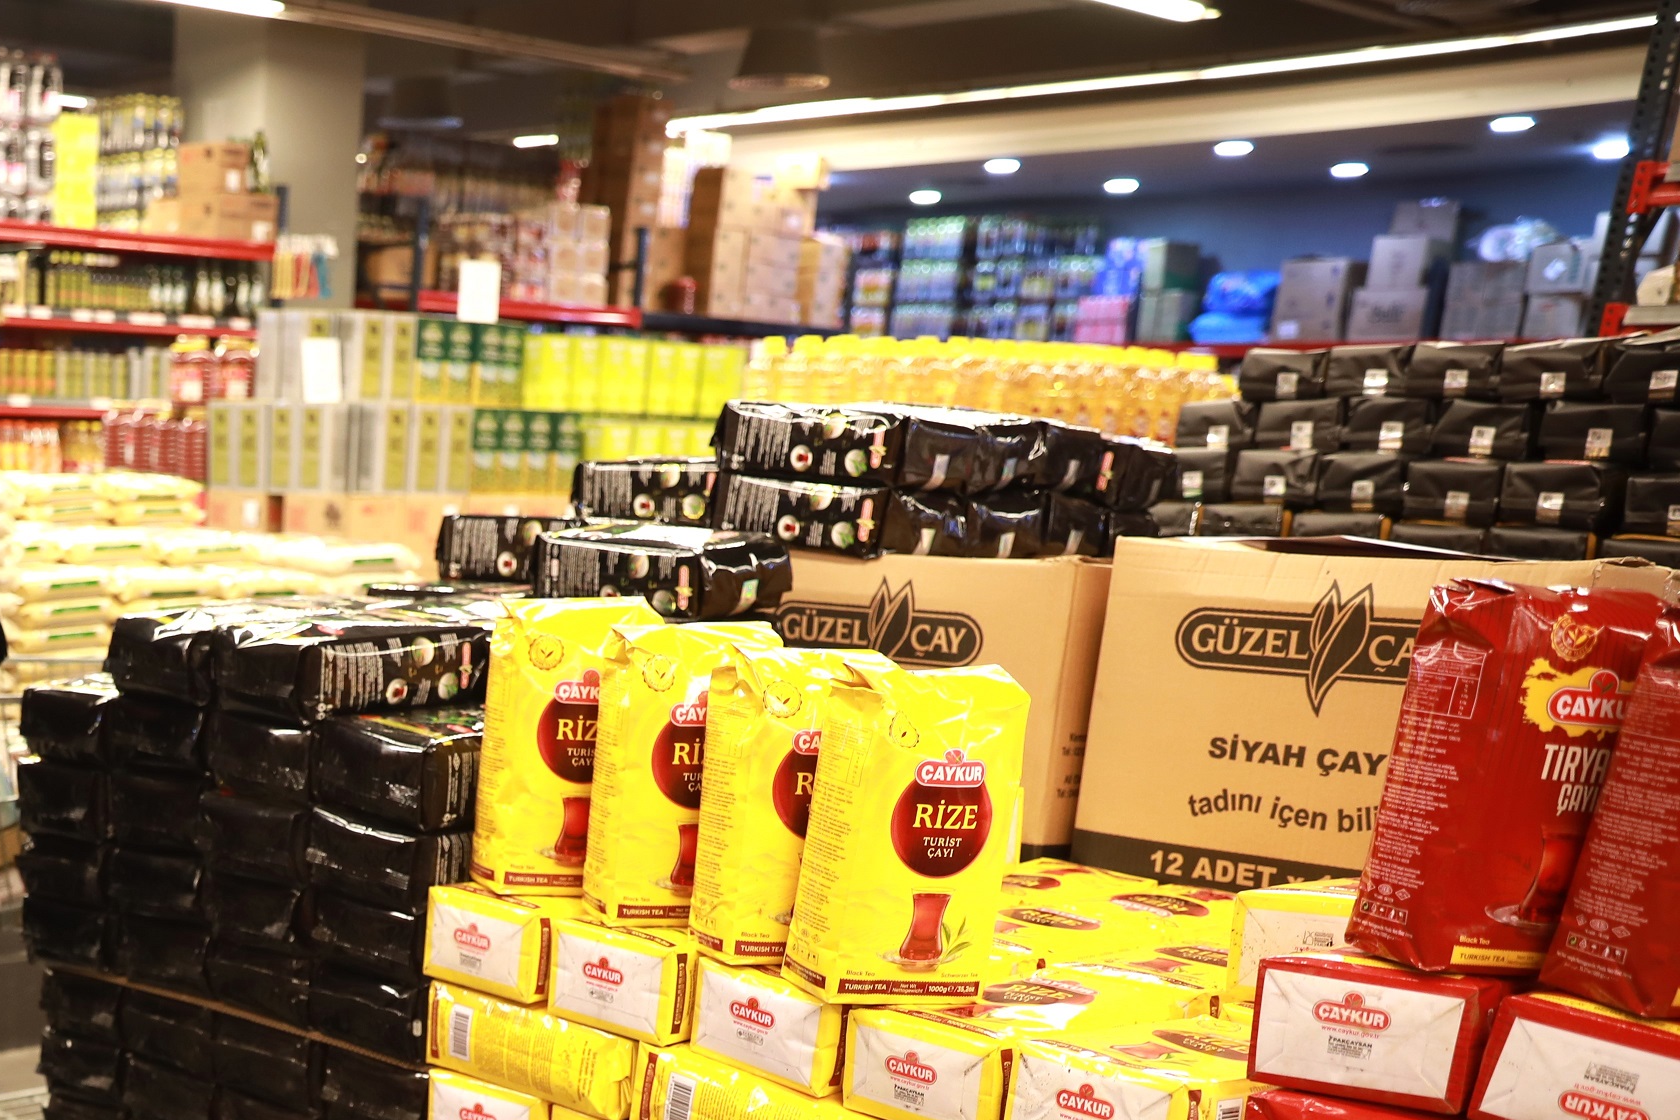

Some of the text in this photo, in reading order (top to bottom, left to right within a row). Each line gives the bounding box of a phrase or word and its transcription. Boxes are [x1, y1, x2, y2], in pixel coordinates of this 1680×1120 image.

[782, 609, 967, 656] GÜZEL ÇAY
[1191, 617, 1309, 661] GÜZEL
[1208, 733, 1388, 777] SİYAH ÇAY
[921, 765, 982, 783] ÇAYKUR
[913, 800, 978, 829] RİZE
[1188, 788, 1262, 817] tadını
[1270, 796, 1328, 832] içen
[923, 836, 962, 847] TURİST
[928, 848, 953, 859] ÇAYI
[1150, 850, 1183, 875] 12
[1191, 856, 1278, 890] ADET
[622, 908, 664, 917] TURKISH TEA
[741, 944, 784, 954] TURKISH TEA
[1459, 935, 1490, 945] Black Tea
[1460, 953, 1490, 961] TURKISH
[928, 985, 948, 993] 1000g
[732, 1006, 772, 1027] ÇAYKUR
[1318, 1004, 1386, 1028] ÇAYKUR
[1321, 1025, 1380, 1040] www.caykur.gov.tr
[889, 1060, 934, 1081] ÇAYKUR
[1059, 1093, 1112, 1118] ÇAYKUR
